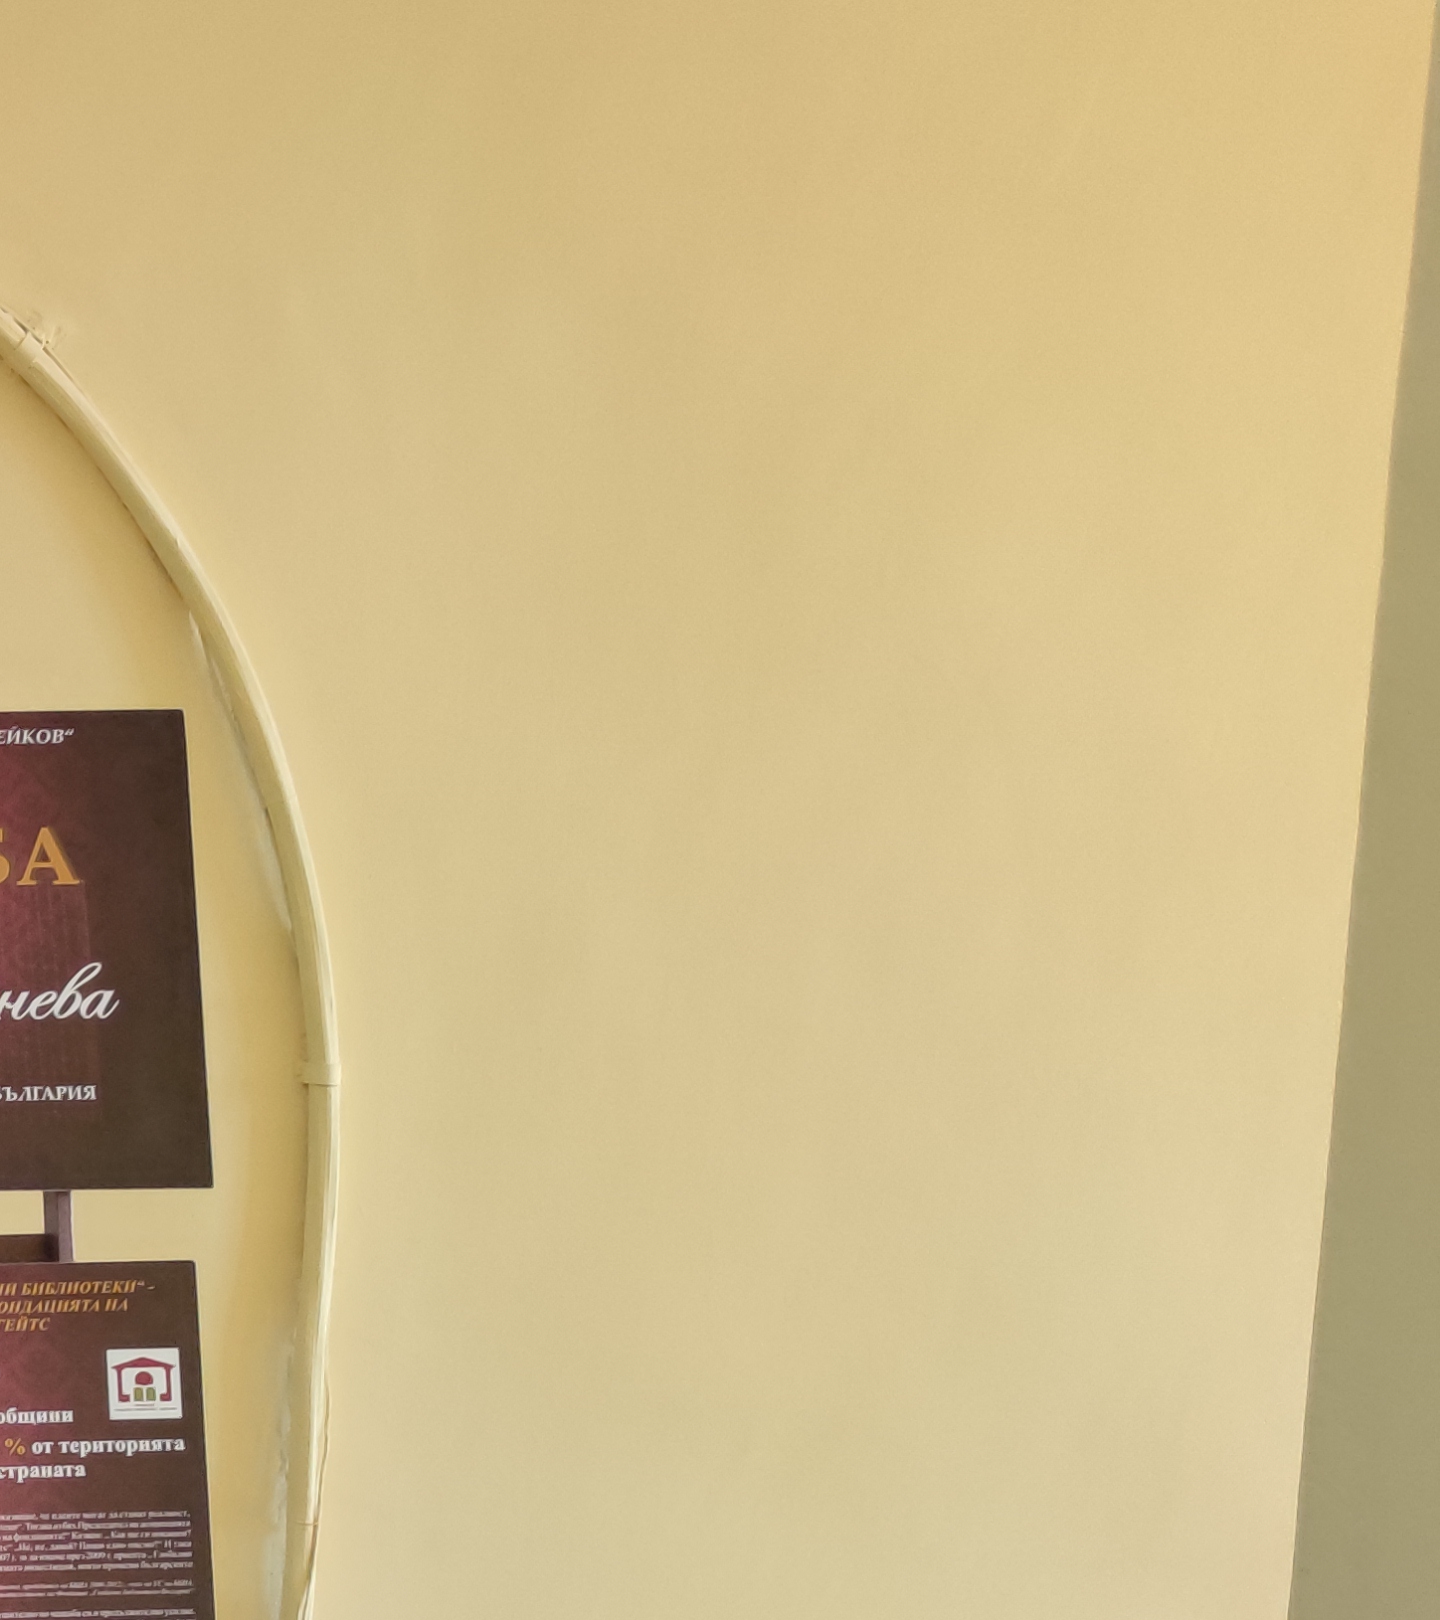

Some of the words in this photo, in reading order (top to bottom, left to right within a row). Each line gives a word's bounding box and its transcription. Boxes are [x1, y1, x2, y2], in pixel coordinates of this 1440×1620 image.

[21, 1280, 144, 1295] БИБЛИОТЕКИ“
[104, 1298, 128, 1311] НА
[4, 1438, 25, 1455] %
[31, 1441, 54, 1454] от
[58, 1438, 185, 1457] територията
